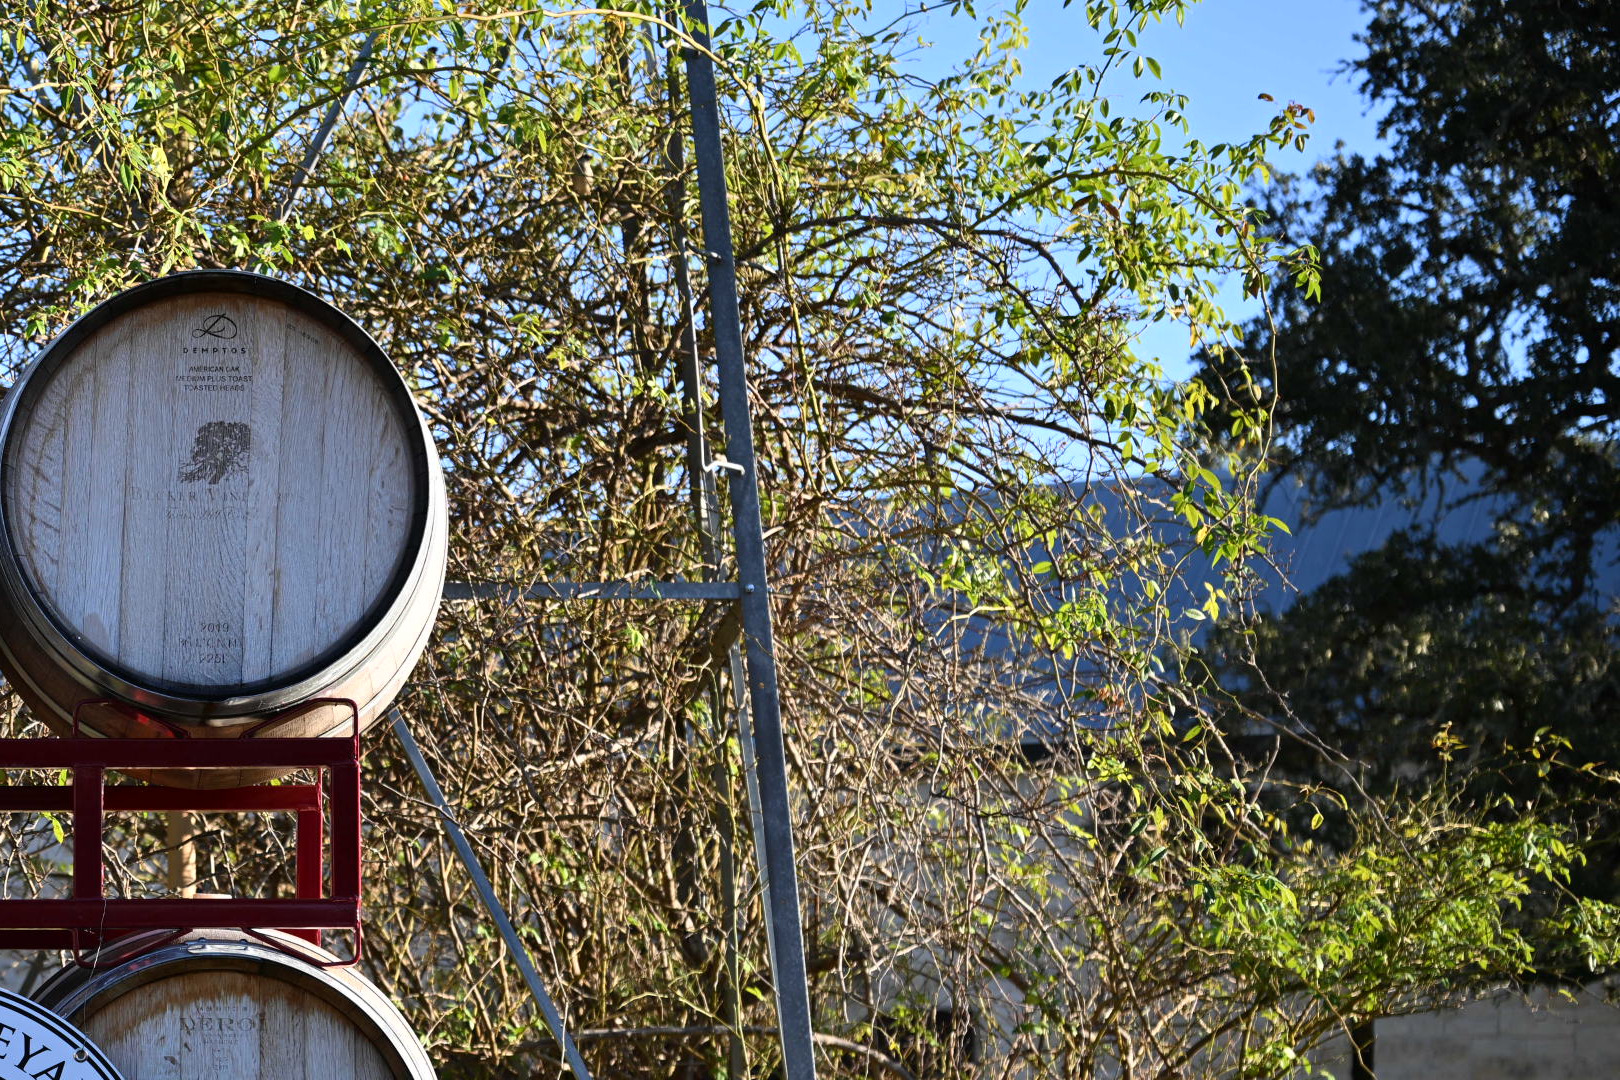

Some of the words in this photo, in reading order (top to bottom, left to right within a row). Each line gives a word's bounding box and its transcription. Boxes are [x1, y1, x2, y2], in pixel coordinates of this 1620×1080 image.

[182, 347, 247, 355] DEMPTOS
[188, 365, 224, 373] AMERICAN
[228, 375, 253, 383] TOAST
